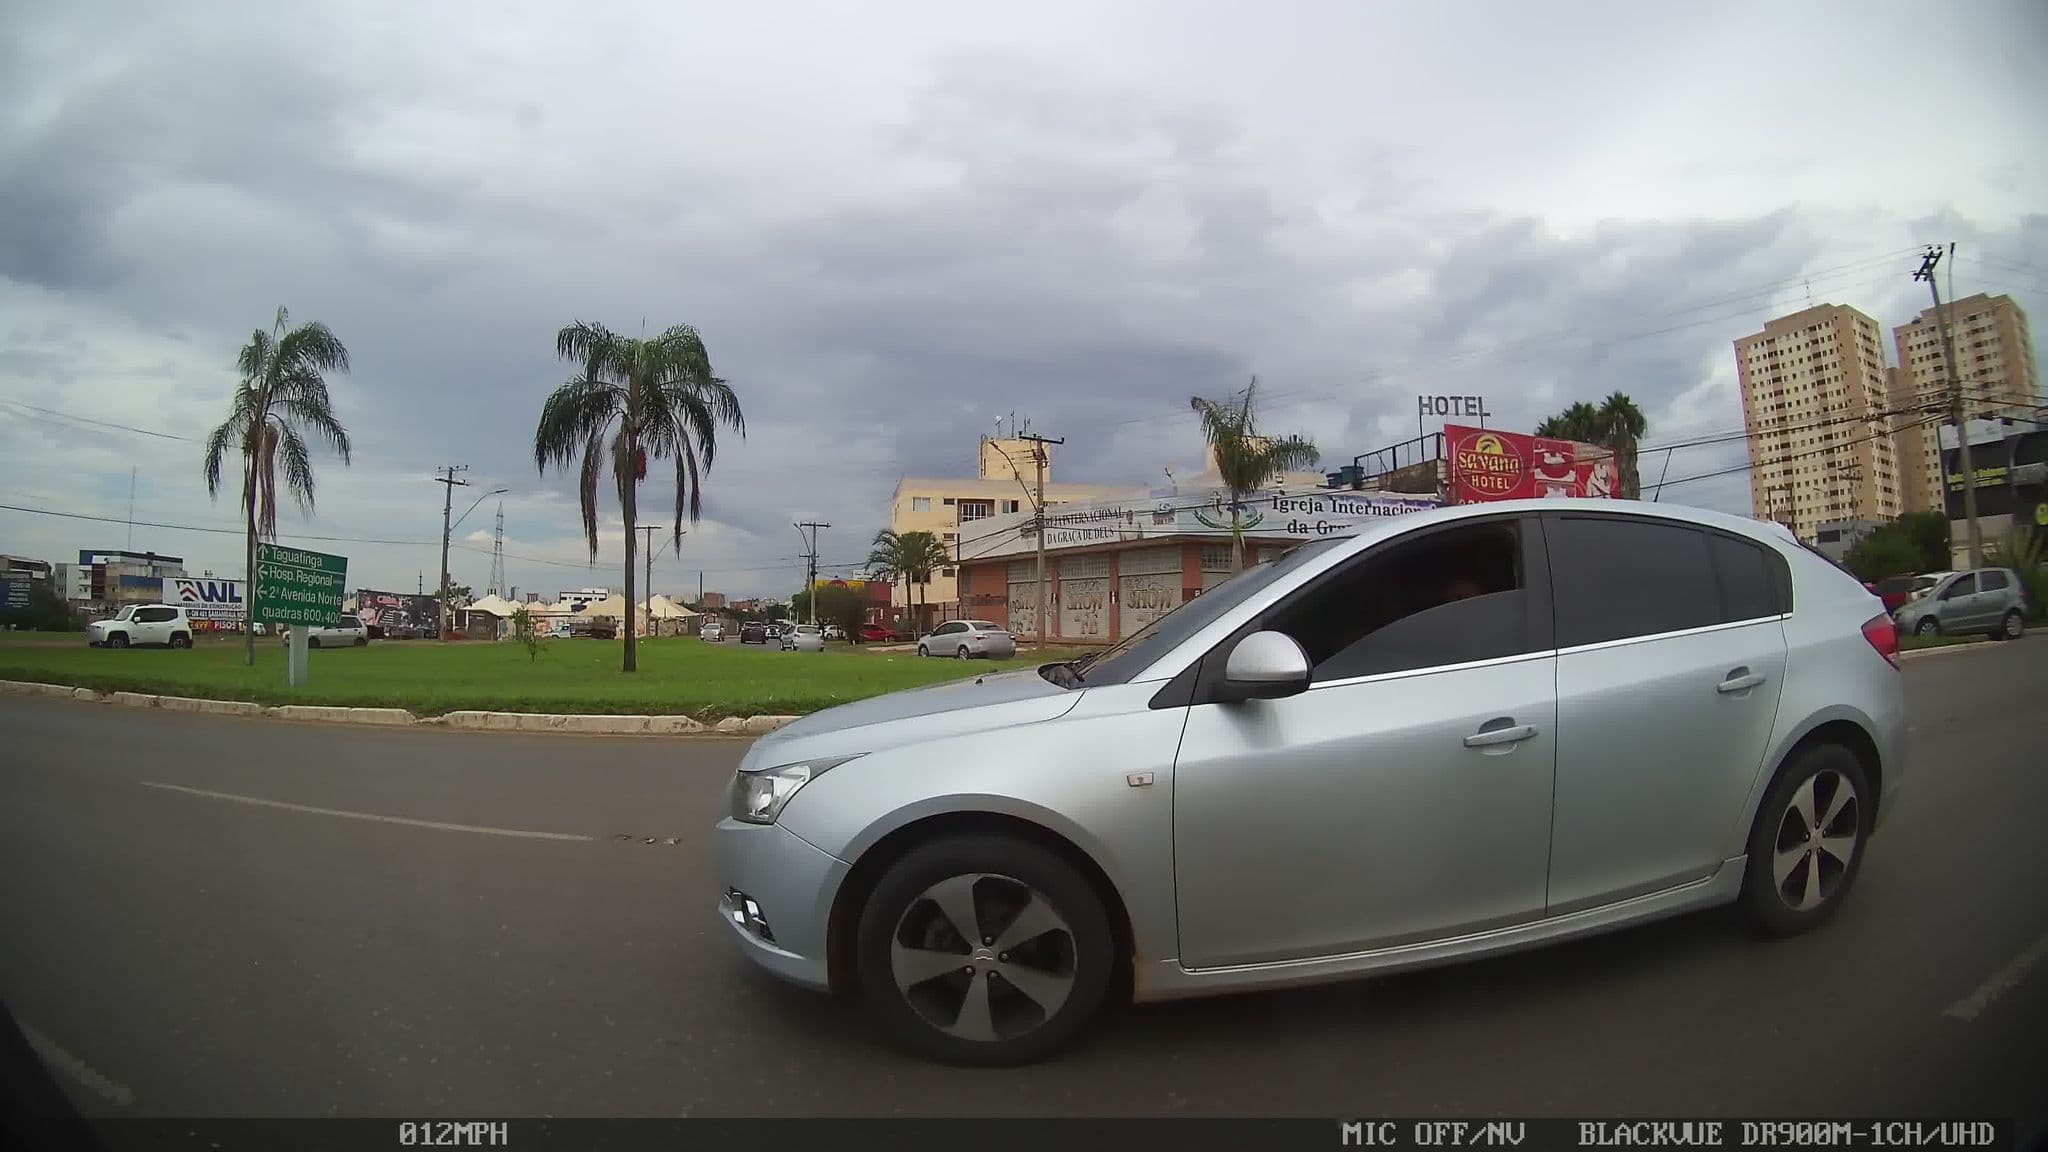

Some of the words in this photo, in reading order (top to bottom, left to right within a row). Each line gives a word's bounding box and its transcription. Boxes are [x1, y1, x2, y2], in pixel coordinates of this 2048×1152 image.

[1418, 396, 1491, 417] HOTEL
[1471, 475, 1510, 490] HOTEL
[1272, 495, 1324, 515] Igreja
[1287, 518, 1309, 534] da
[271, 546, 323, 568] Taguatinga
[269, 565, 296, 583] Hosp.
[296, 569, 333, 586] Regional
[195, 581, 243, 603] WL
[280, 587, 316, 603] Avenida
[317, 591, 343, 606] Norte
[262, 606, 302, 620] quadras
